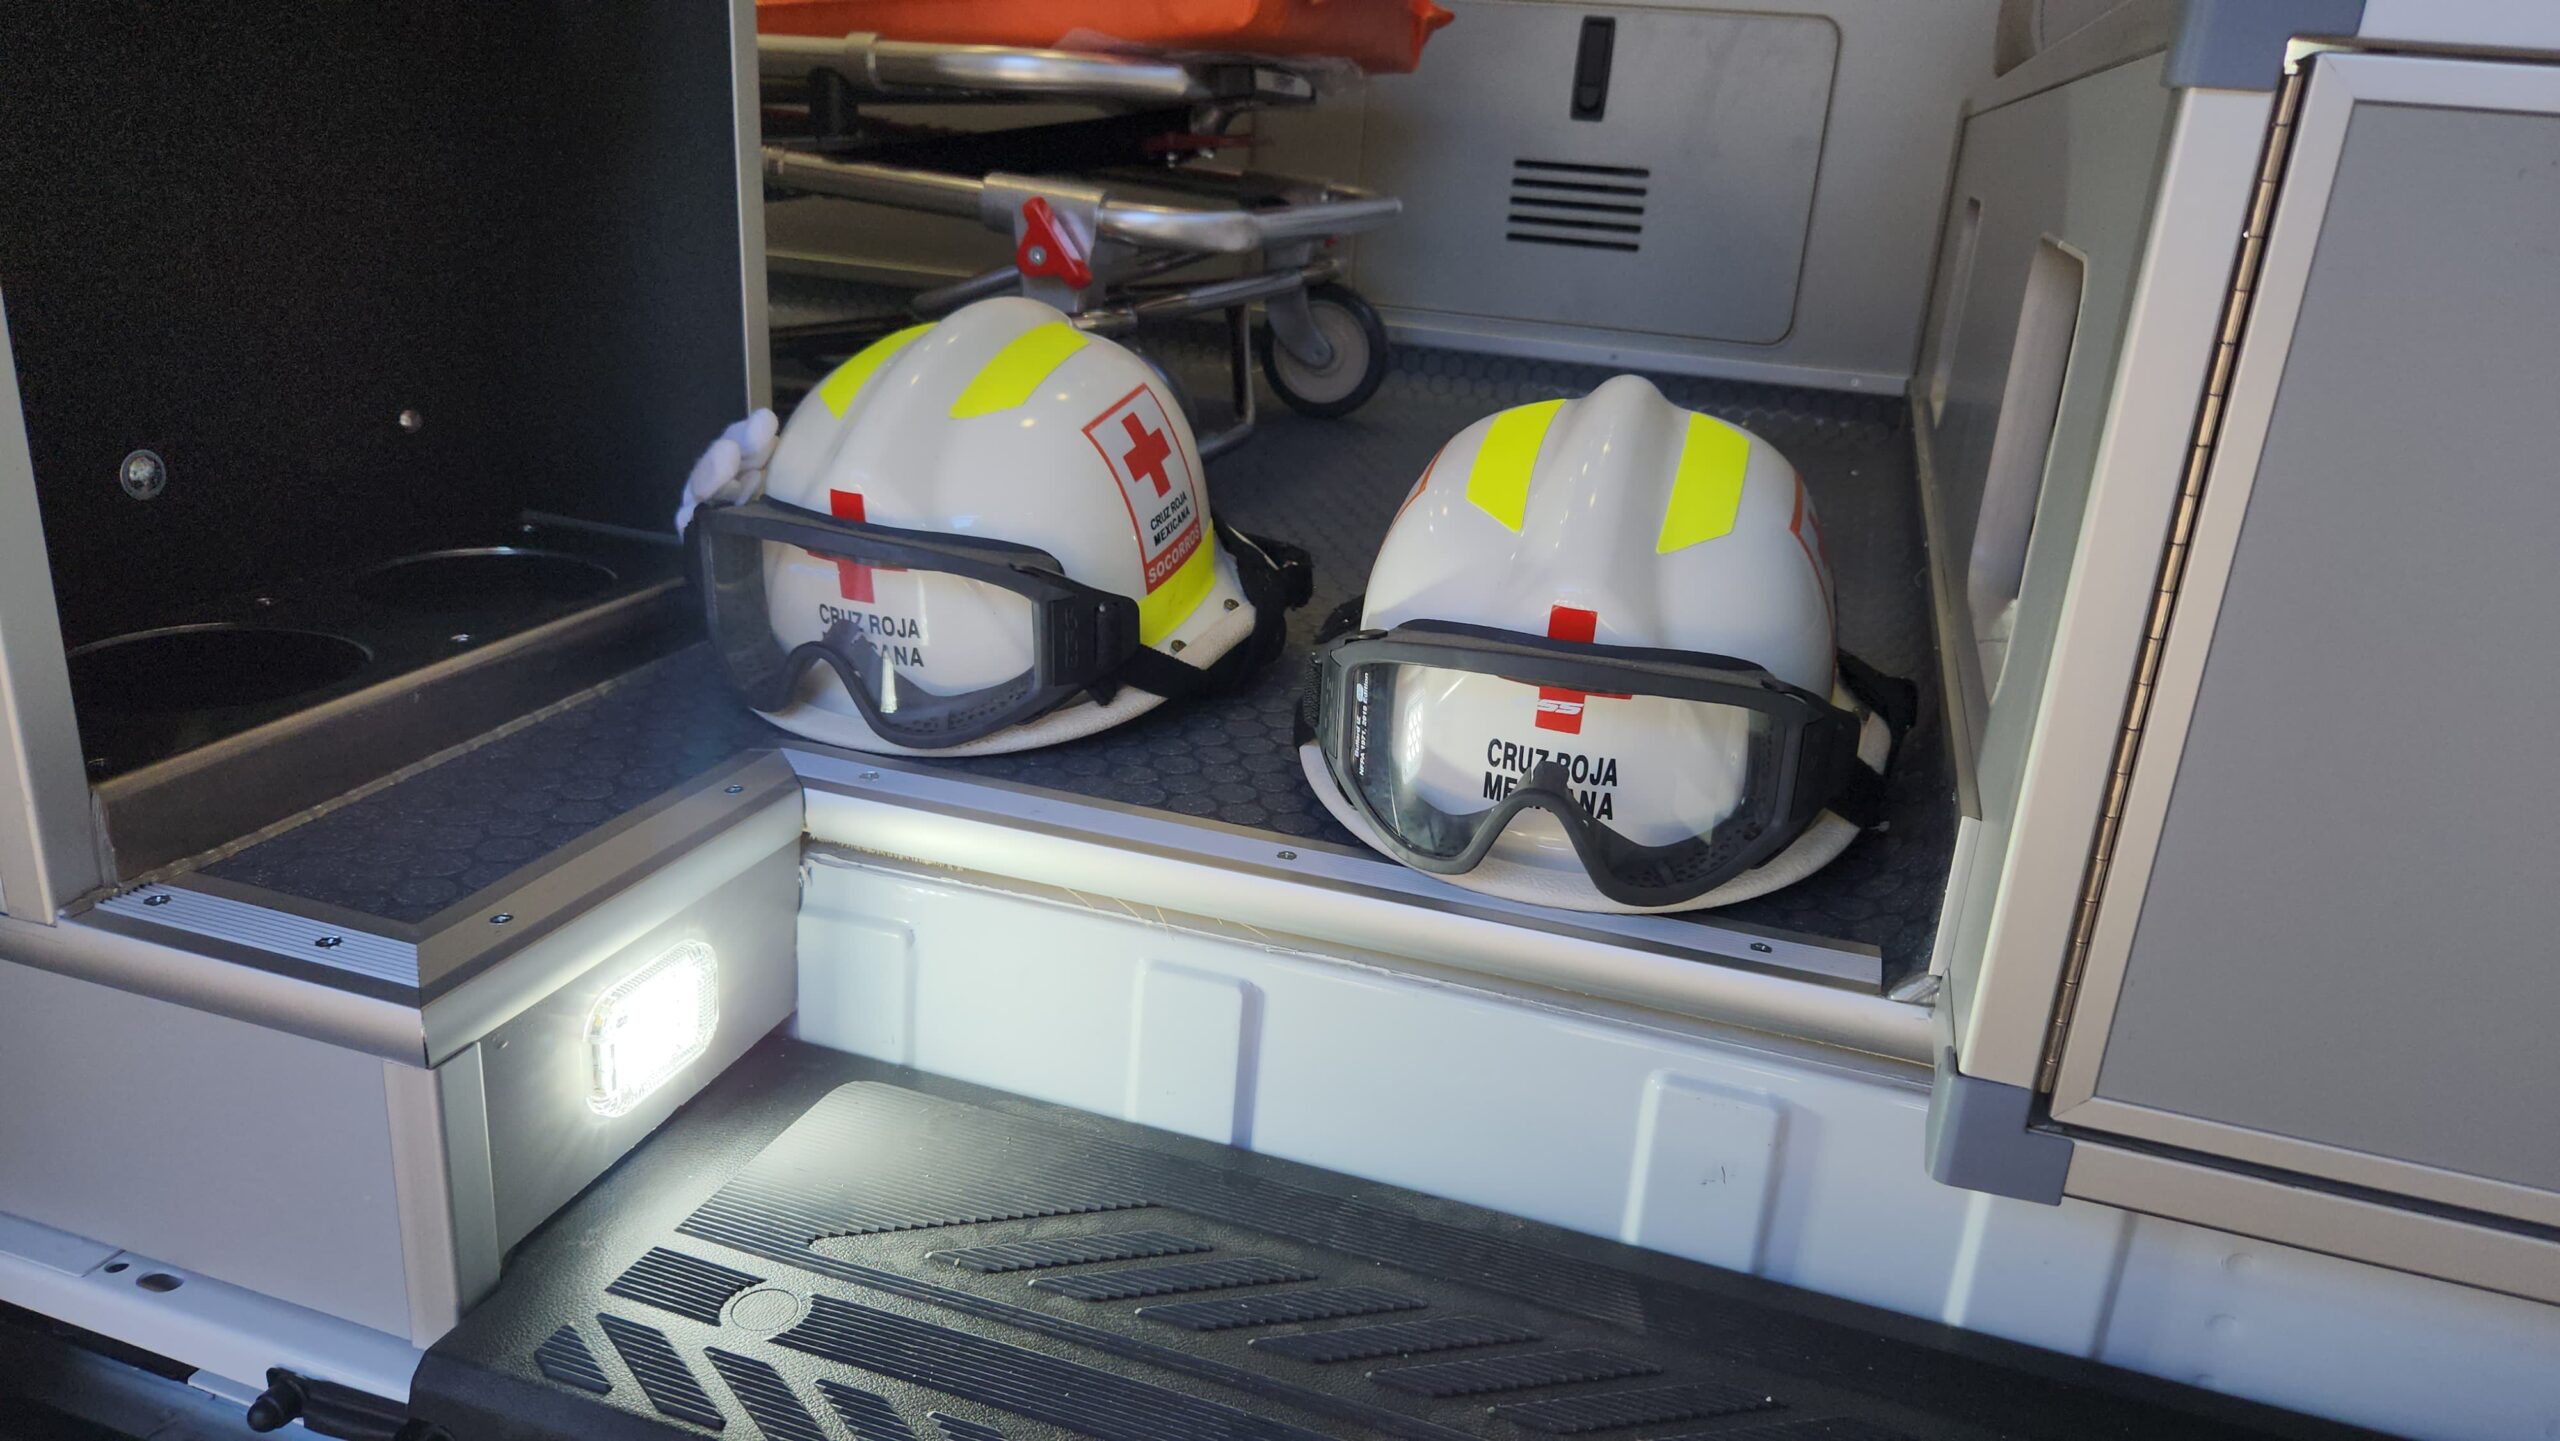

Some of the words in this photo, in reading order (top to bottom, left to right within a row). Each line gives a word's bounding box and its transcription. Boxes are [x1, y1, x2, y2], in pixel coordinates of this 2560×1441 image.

[1150, 506, 1171, 530] CRUZ
[1170, 491, 1187, 513] ROJA
[1153, 506, 1190, 546] MEXICANA
[1148, 524, 1200, 583] SOCORROS
[869, 614, 921, 639] ROJA
[1483, 771, 1613, 820] MENA
